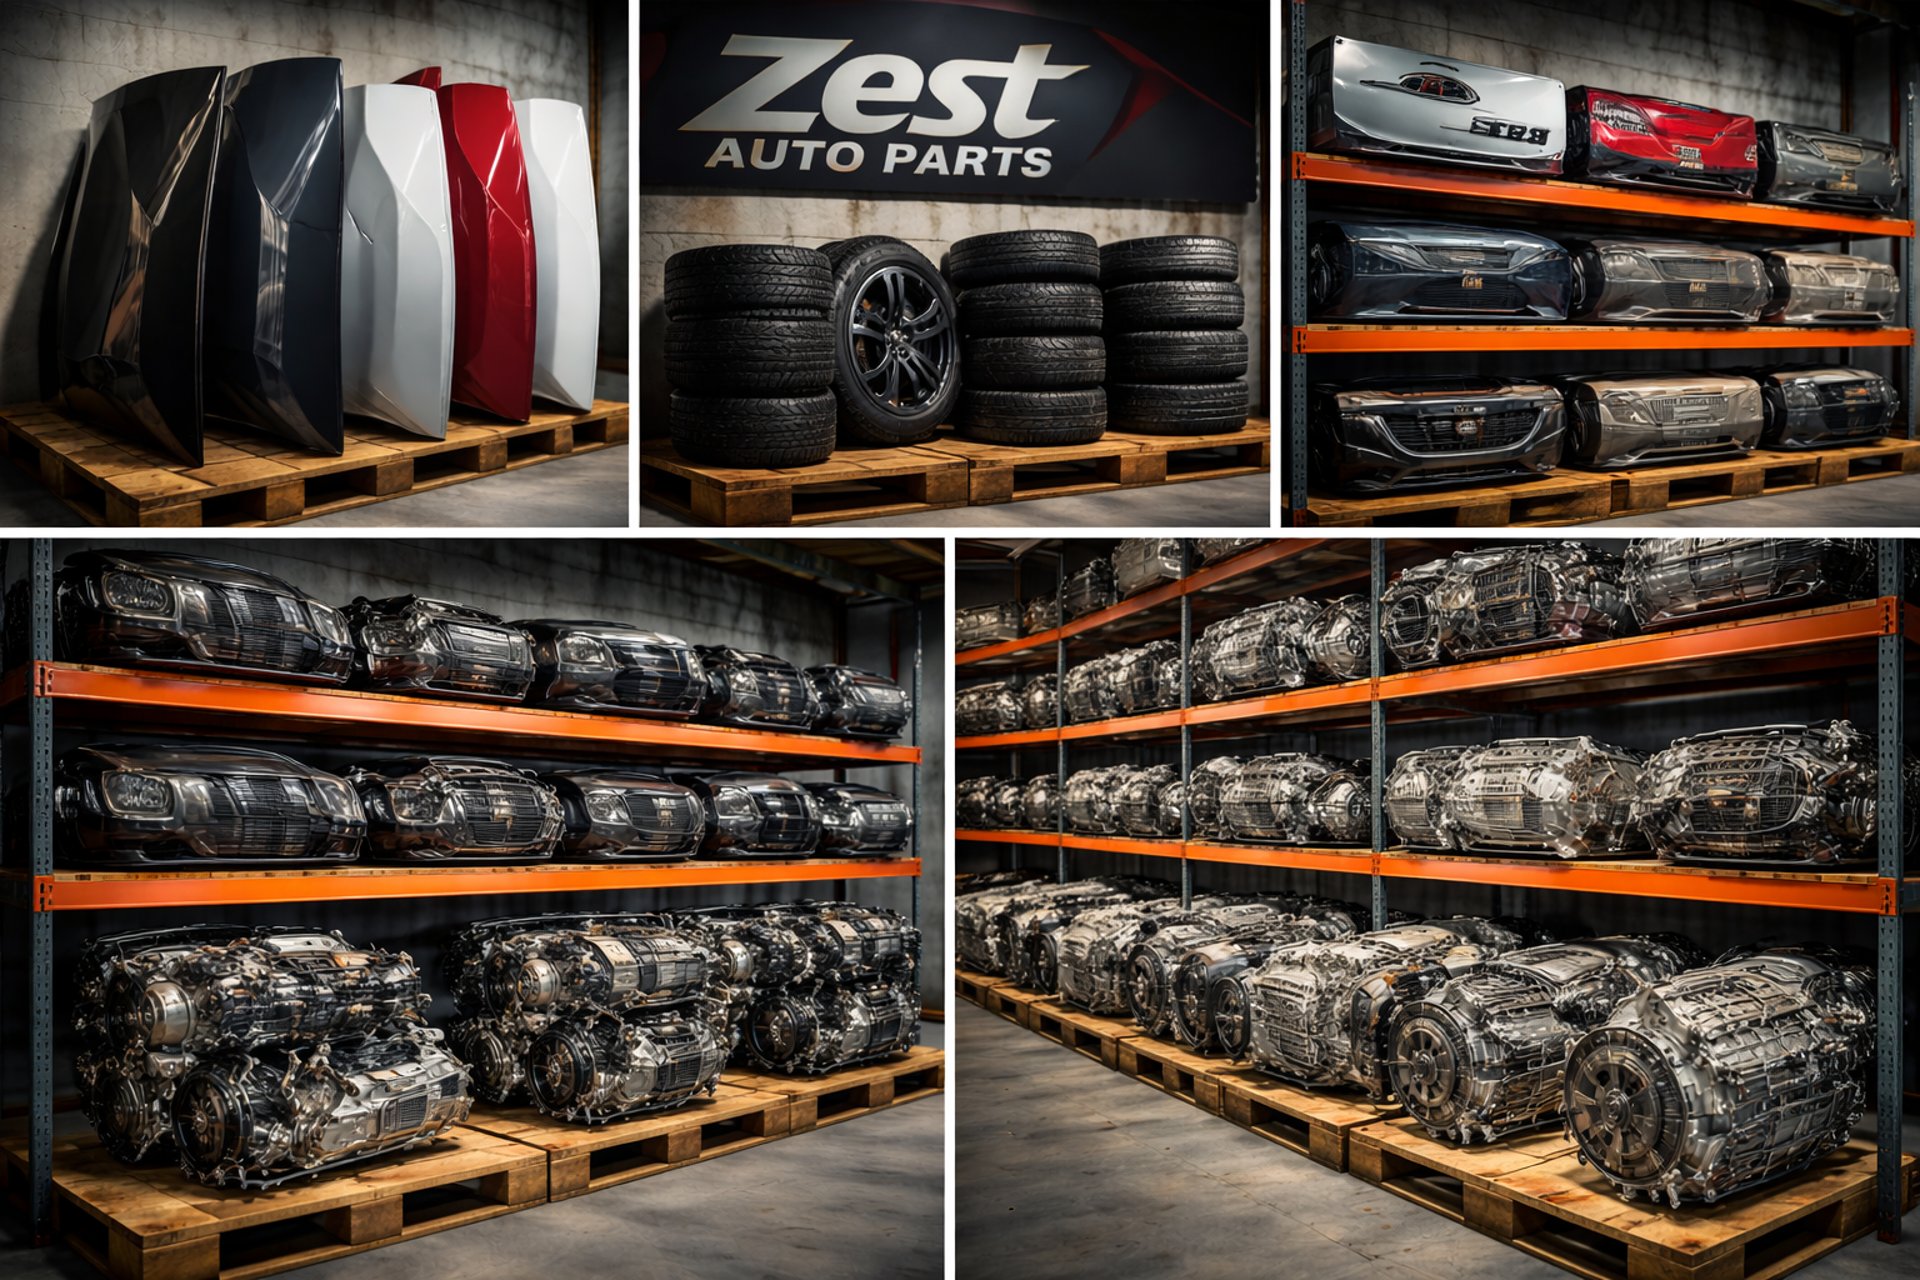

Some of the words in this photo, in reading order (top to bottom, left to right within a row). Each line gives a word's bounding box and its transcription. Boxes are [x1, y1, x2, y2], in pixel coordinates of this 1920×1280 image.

[677, 34, 1091, 139] Zest
[704, 138, 865, 173] AUTO
[882, 143, 1053, 178] PARTS
